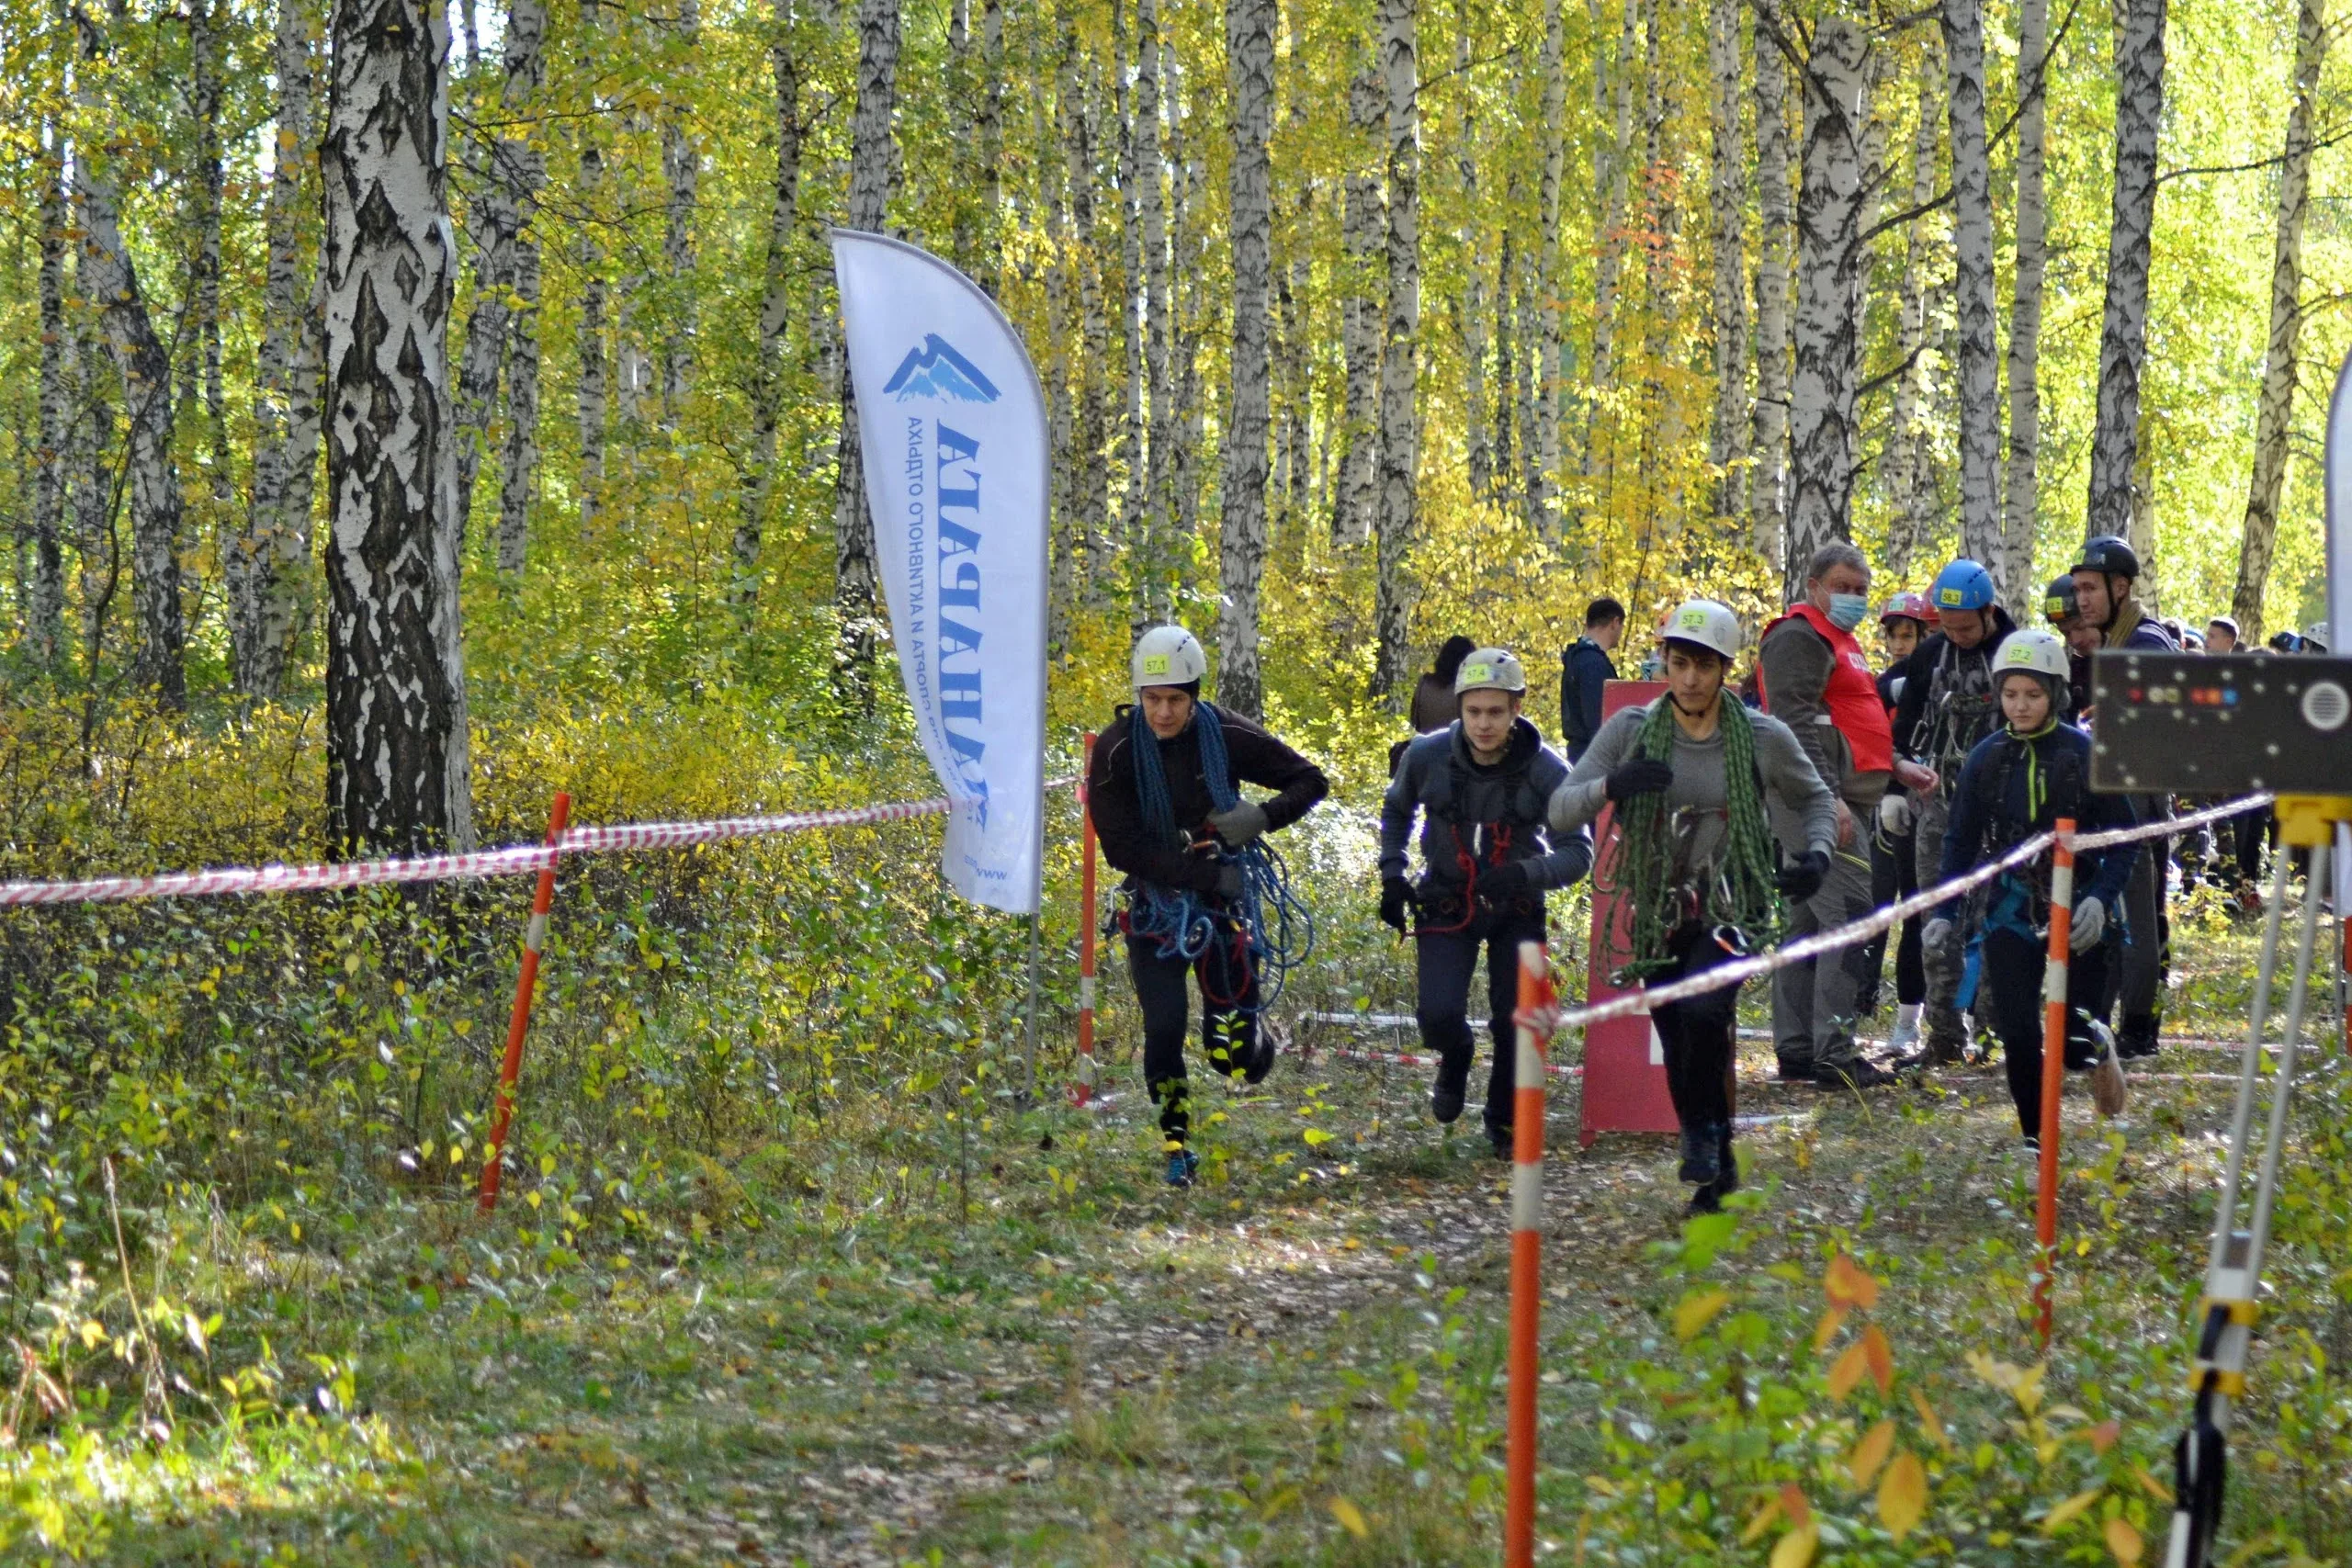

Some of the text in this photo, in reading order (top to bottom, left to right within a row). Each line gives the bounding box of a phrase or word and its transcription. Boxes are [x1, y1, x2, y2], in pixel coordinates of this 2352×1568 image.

[1682, 615, 1704, 625] 57.3
[2009, 649, 2032, 660] 57.2
[1146, 660, 1166, 671] 57.1
